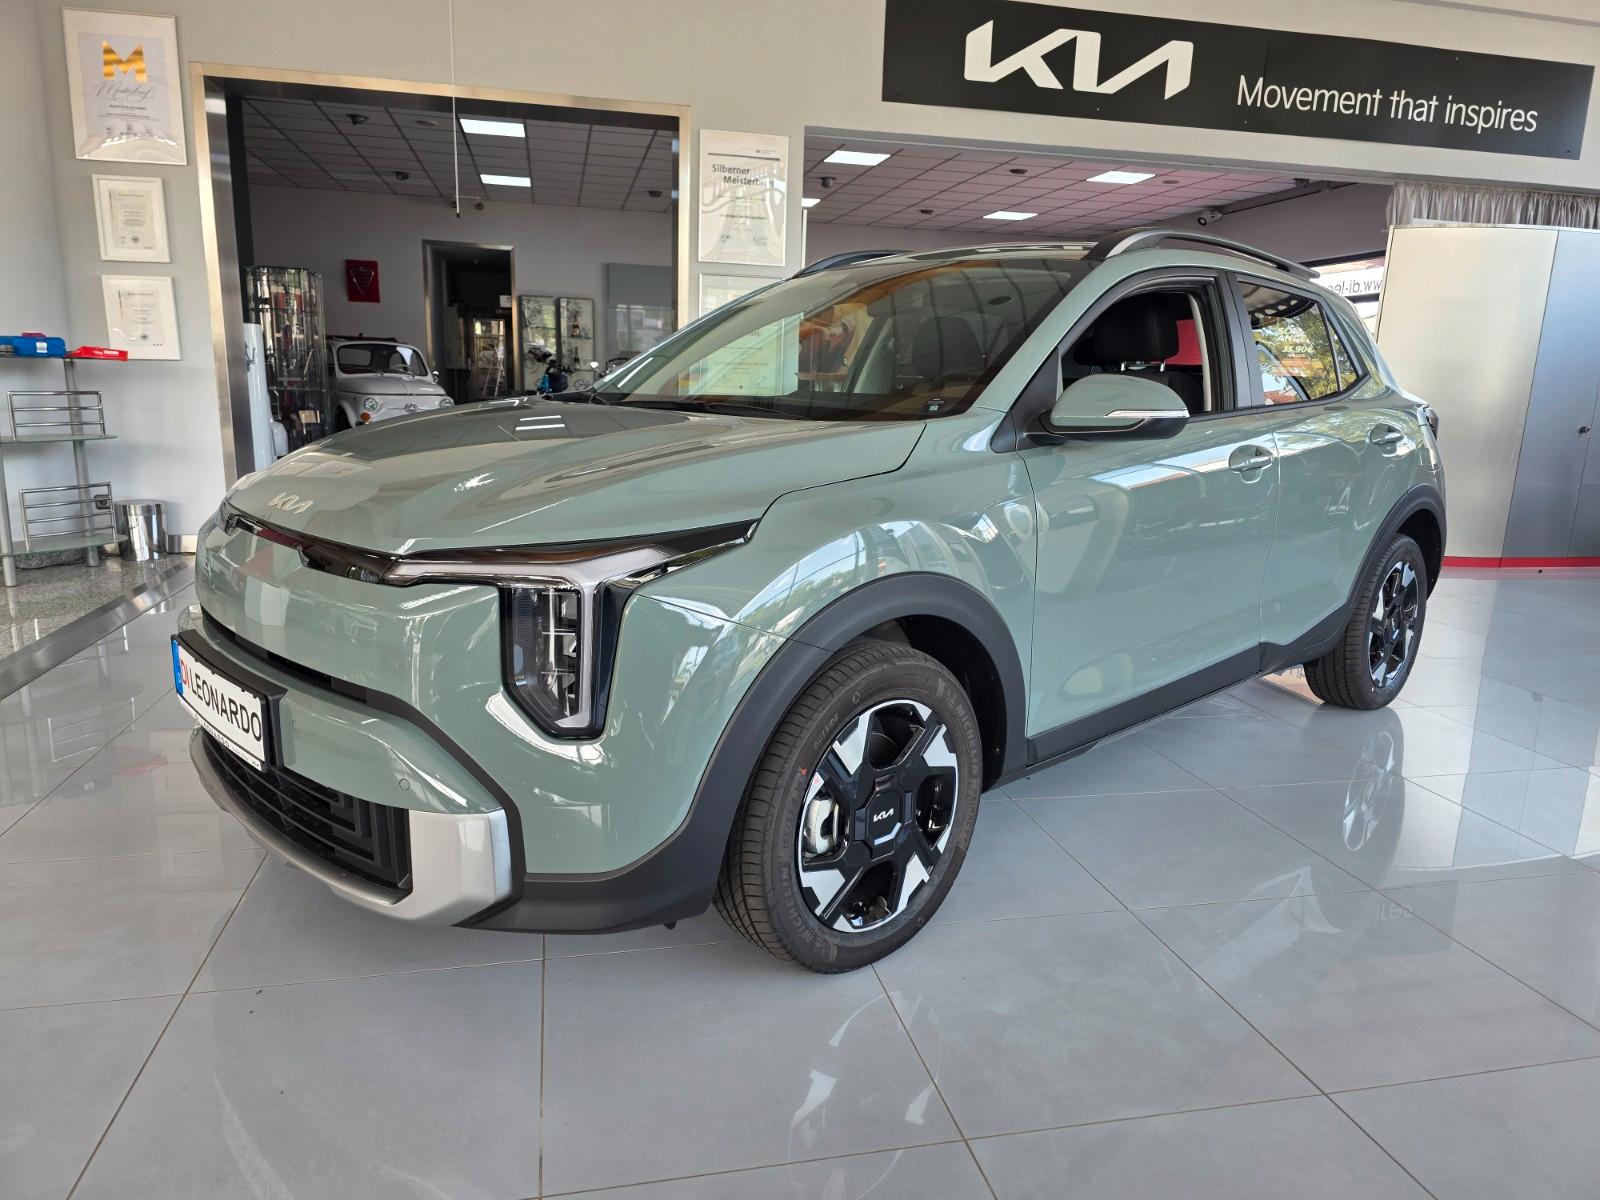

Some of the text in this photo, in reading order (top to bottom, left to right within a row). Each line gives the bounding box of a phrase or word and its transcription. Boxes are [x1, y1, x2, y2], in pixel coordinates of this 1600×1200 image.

[964, 20, 1194, 100] KIA
[1236, 75, 1539, 134] Movement that inspires
[712, 164, 751, 174] Silberner
[189, 667, 262, 742] LEONARDO
[953, 701, 980, 777] MICHELIN
[873, 808, 894, 822] KIA
